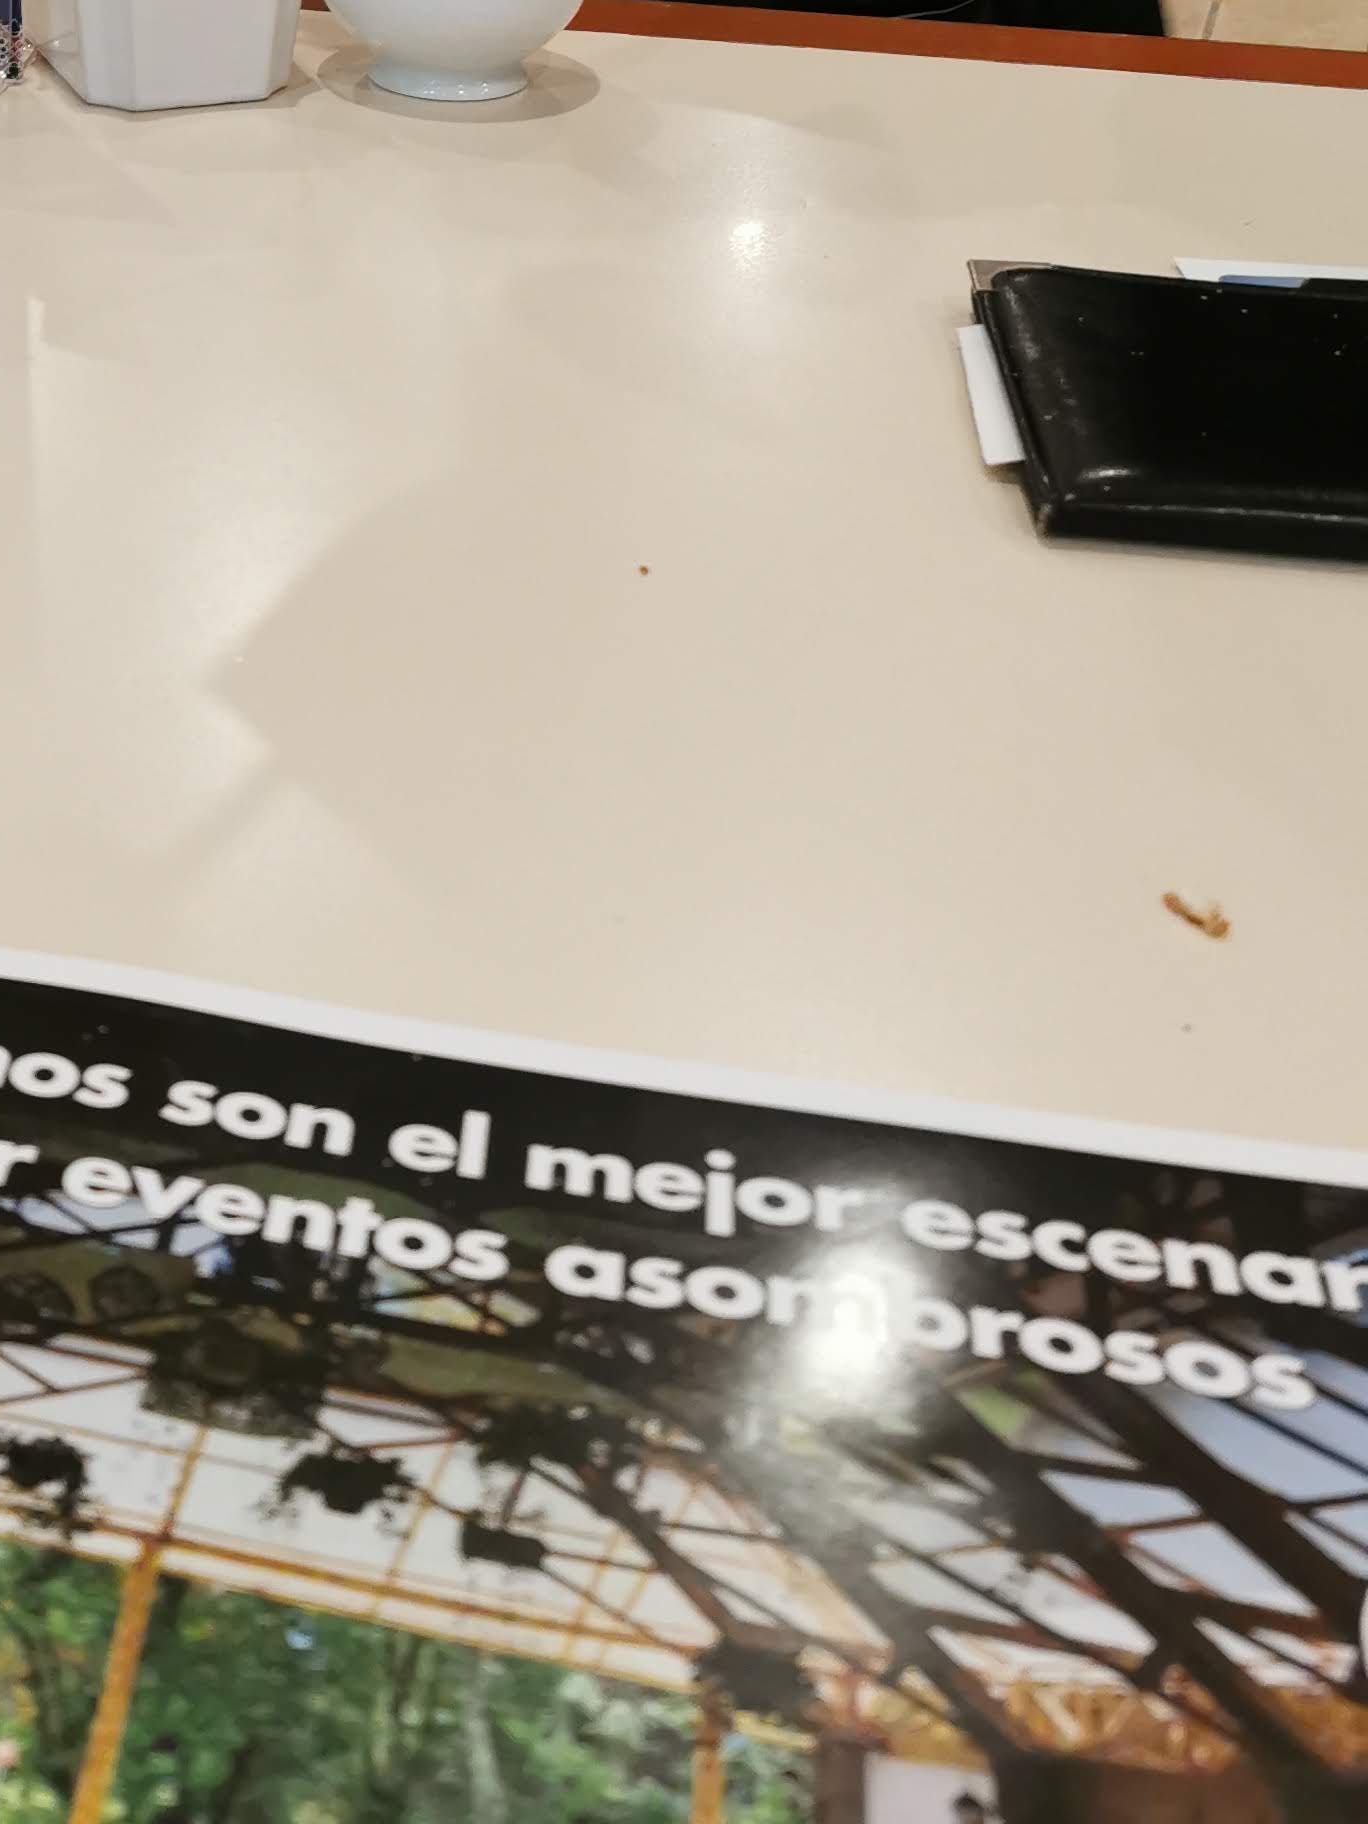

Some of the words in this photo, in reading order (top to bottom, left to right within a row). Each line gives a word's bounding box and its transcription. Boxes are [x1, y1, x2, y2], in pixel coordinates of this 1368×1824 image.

[60, 1155, 511, 1281] eventos
[158, 1077, 355, 1157] son
[387, 1109, 492, 1180] el
[525, 1140, 866, 1238] mejor
